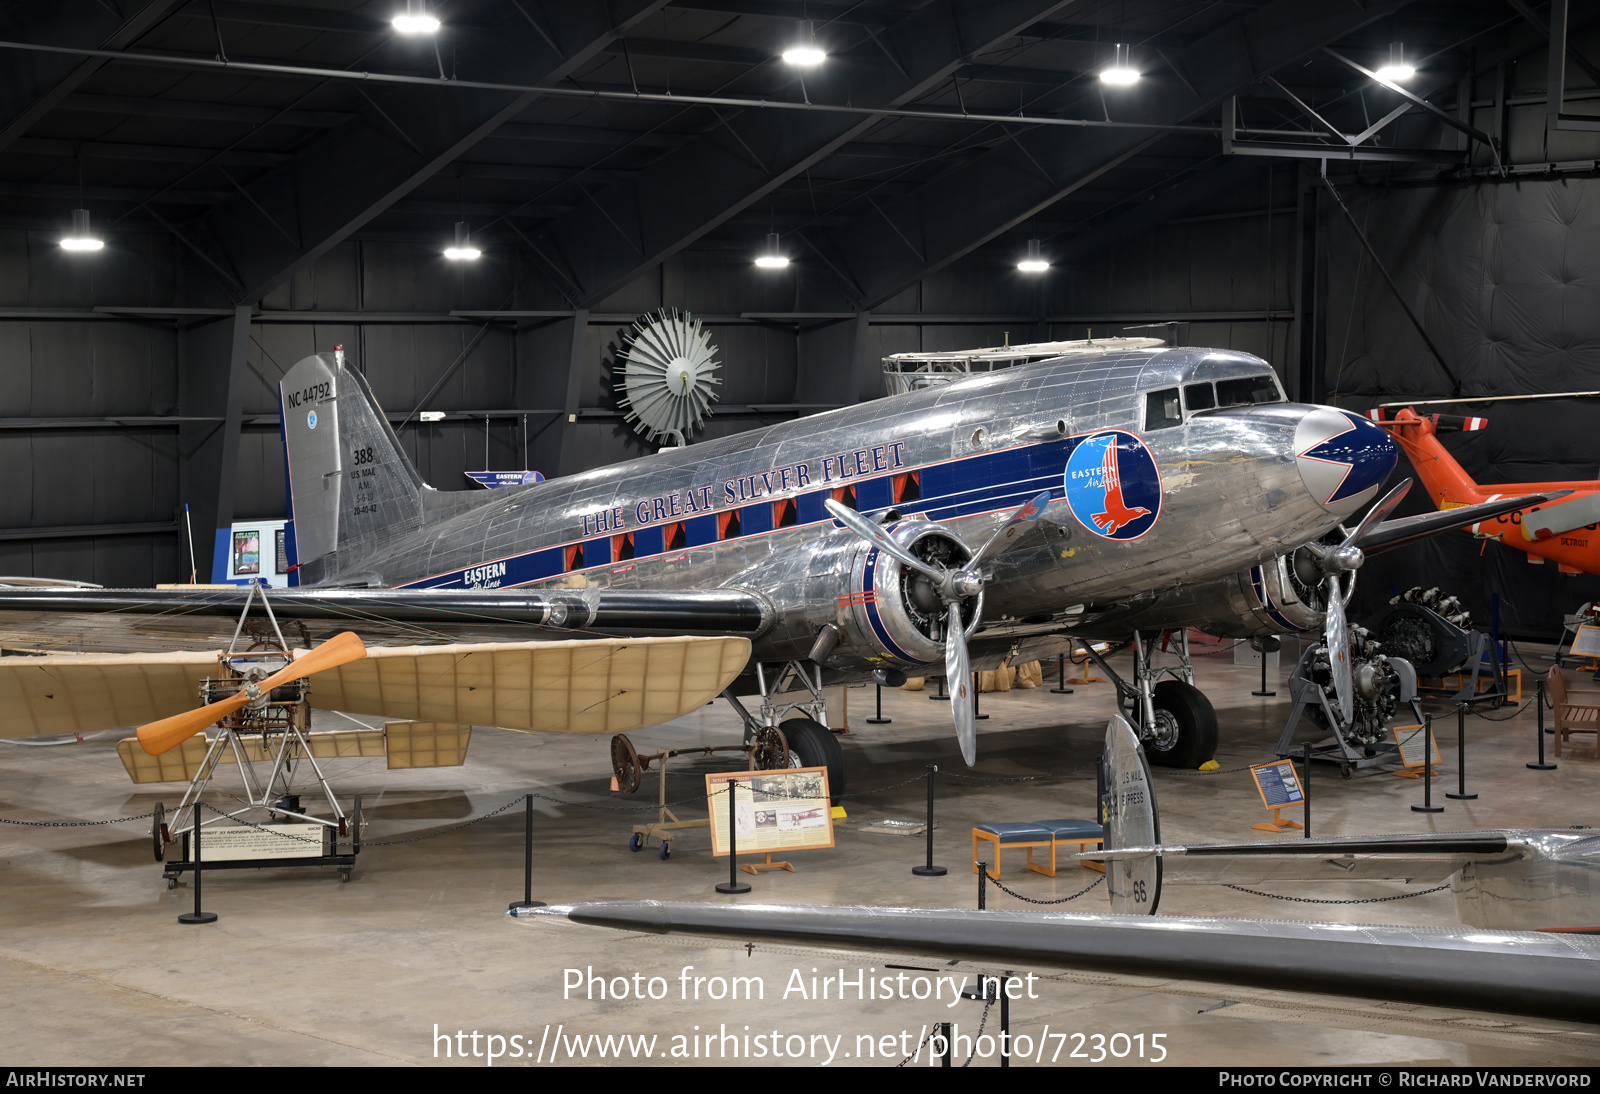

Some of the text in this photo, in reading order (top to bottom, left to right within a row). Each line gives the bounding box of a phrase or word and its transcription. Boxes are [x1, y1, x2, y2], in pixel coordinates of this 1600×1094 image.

[288, 381, 331, 409] NC 44792
[353, 447, 374, 466] 388
[1071, 465, 1116, 480] EASTERN
[1084, 477, 1099, 488] Air
[578, 441, 905, 537] THE GREAT SILVER FLEET
[1560, 536, 1589, 549] DETROIT
[464, 561, 506, 586] EASTERN
[1133, 879, 1147, 904] 66
